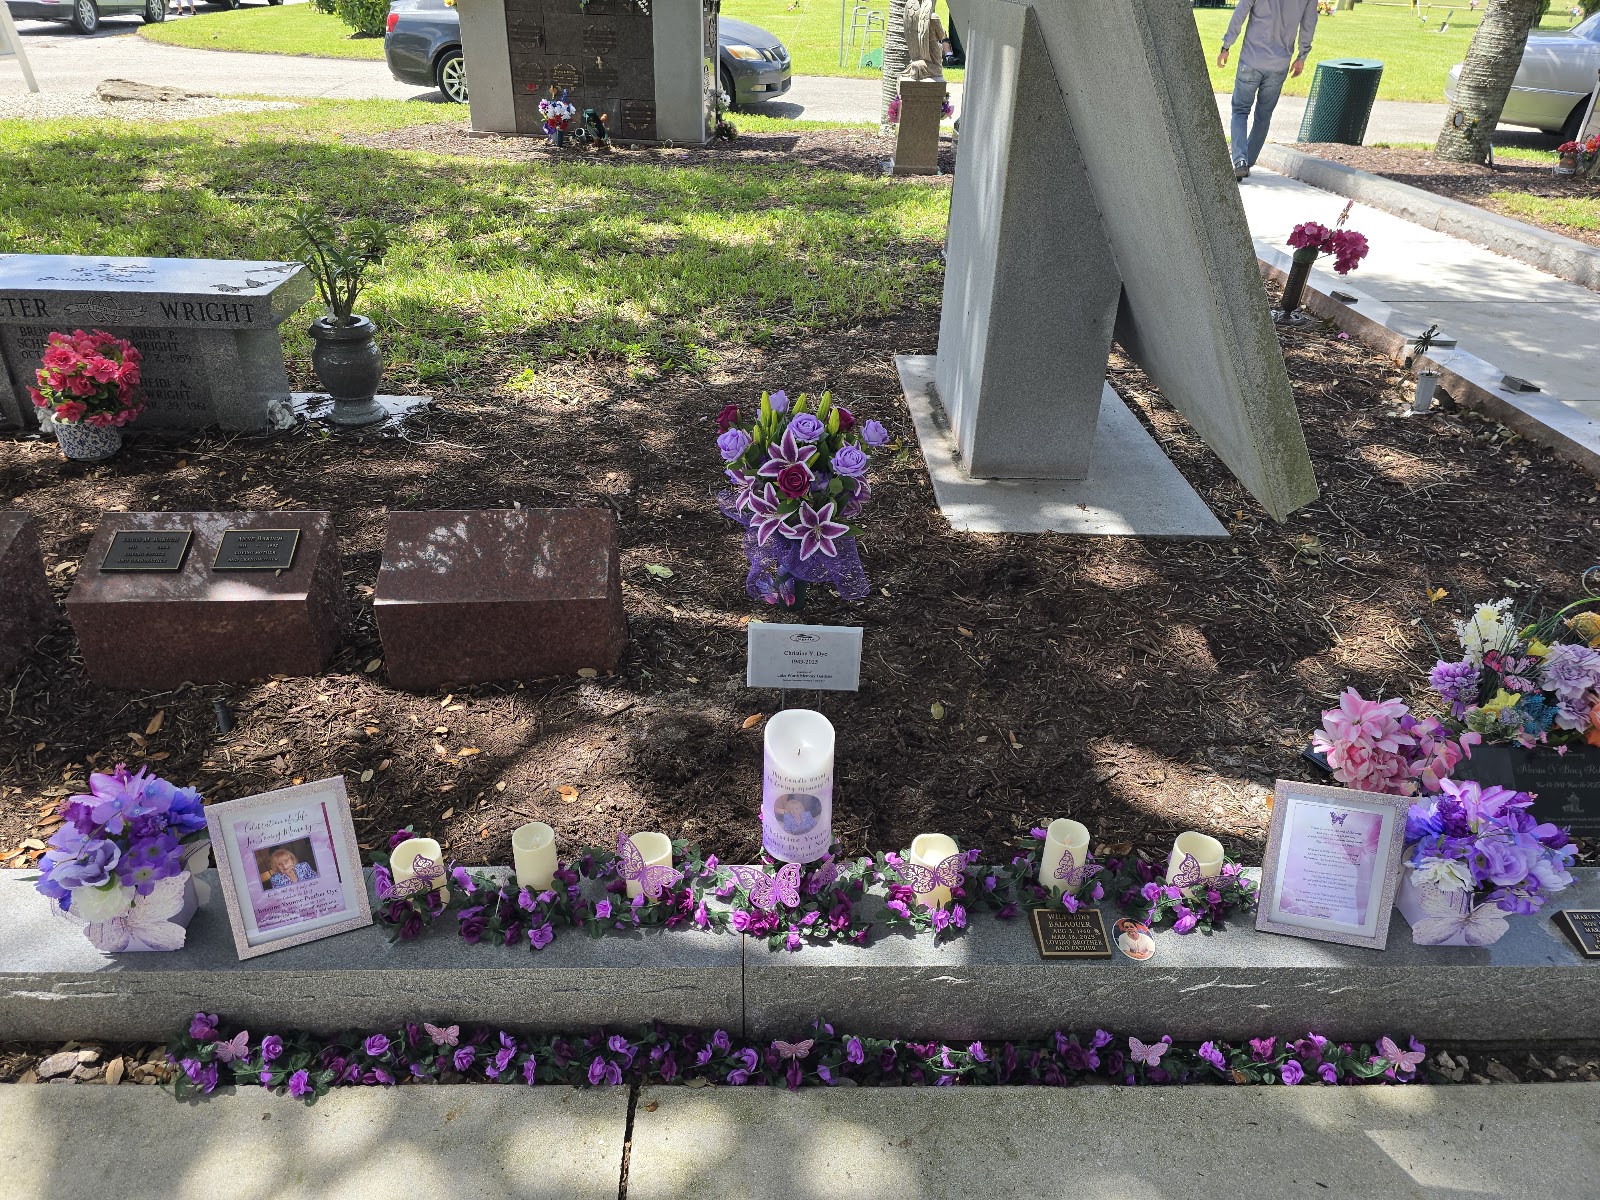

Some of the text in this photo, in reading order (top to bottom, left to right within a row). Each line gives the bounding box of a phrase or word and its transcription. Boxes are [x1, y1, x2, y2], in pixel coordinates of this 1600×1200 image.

[0, 297, 51, 318] TER
[159, 301, 255, 323] WRIGHT
[129, 329, 178, 340] JOHN P.
[132, 341, 179, 352] WRIGHT
[170, 354, 192, 364] 1959
[140, 378, 171, 388] HEIDI
[145, 390, 191, 400] WRIGHT
